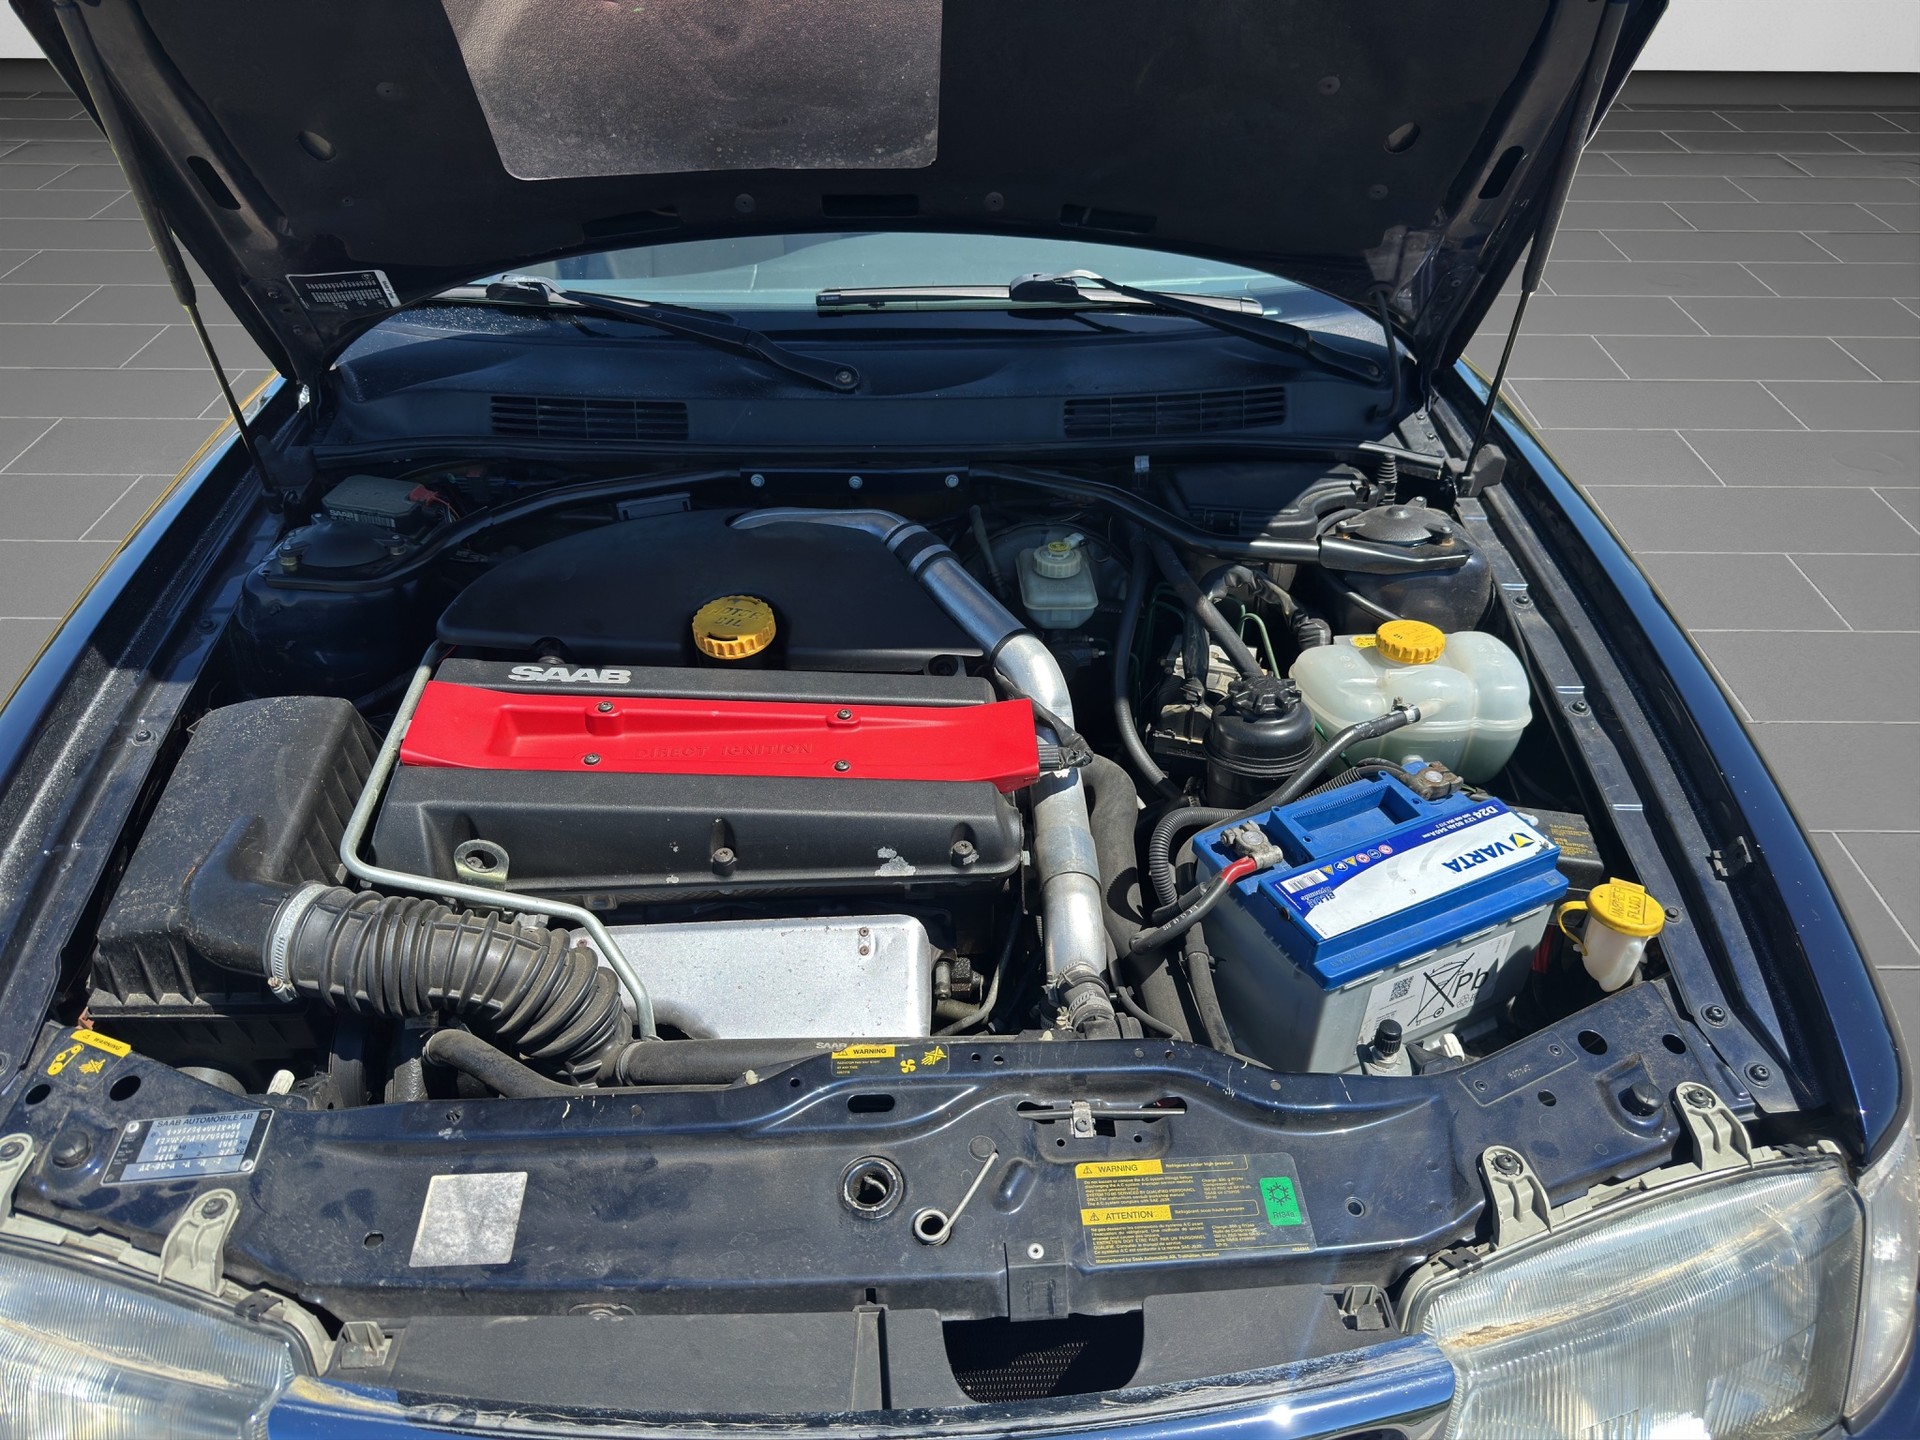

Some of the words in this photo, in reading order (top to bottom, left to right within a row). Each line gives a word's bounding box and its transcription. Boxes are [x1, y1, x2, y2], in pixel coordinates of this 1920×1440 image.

[508, 666, 631, 684] SAAB
[640, 747, 708, 758] DIRECT
[722, 744, 812, 756] IGNITION
[1473, 806, 1498, 819] D24
[1441, 842, 1515, 873] VARTA
[1306, 891, 1335, 908] BLUE
[1453, 968, 1489, 998] Pb
[94, 1037, 122, 1051] WARNING
[157, 1120, 182, 1128] SAAB
[183, 1115, 239, 1125] AUTOMOBILE
[1098, 1164, 1138, 1173] WARNING
[1106, 1211, 1153, 1220] ATTENTION
[1273, 1211, 1295, 1219] R134a
